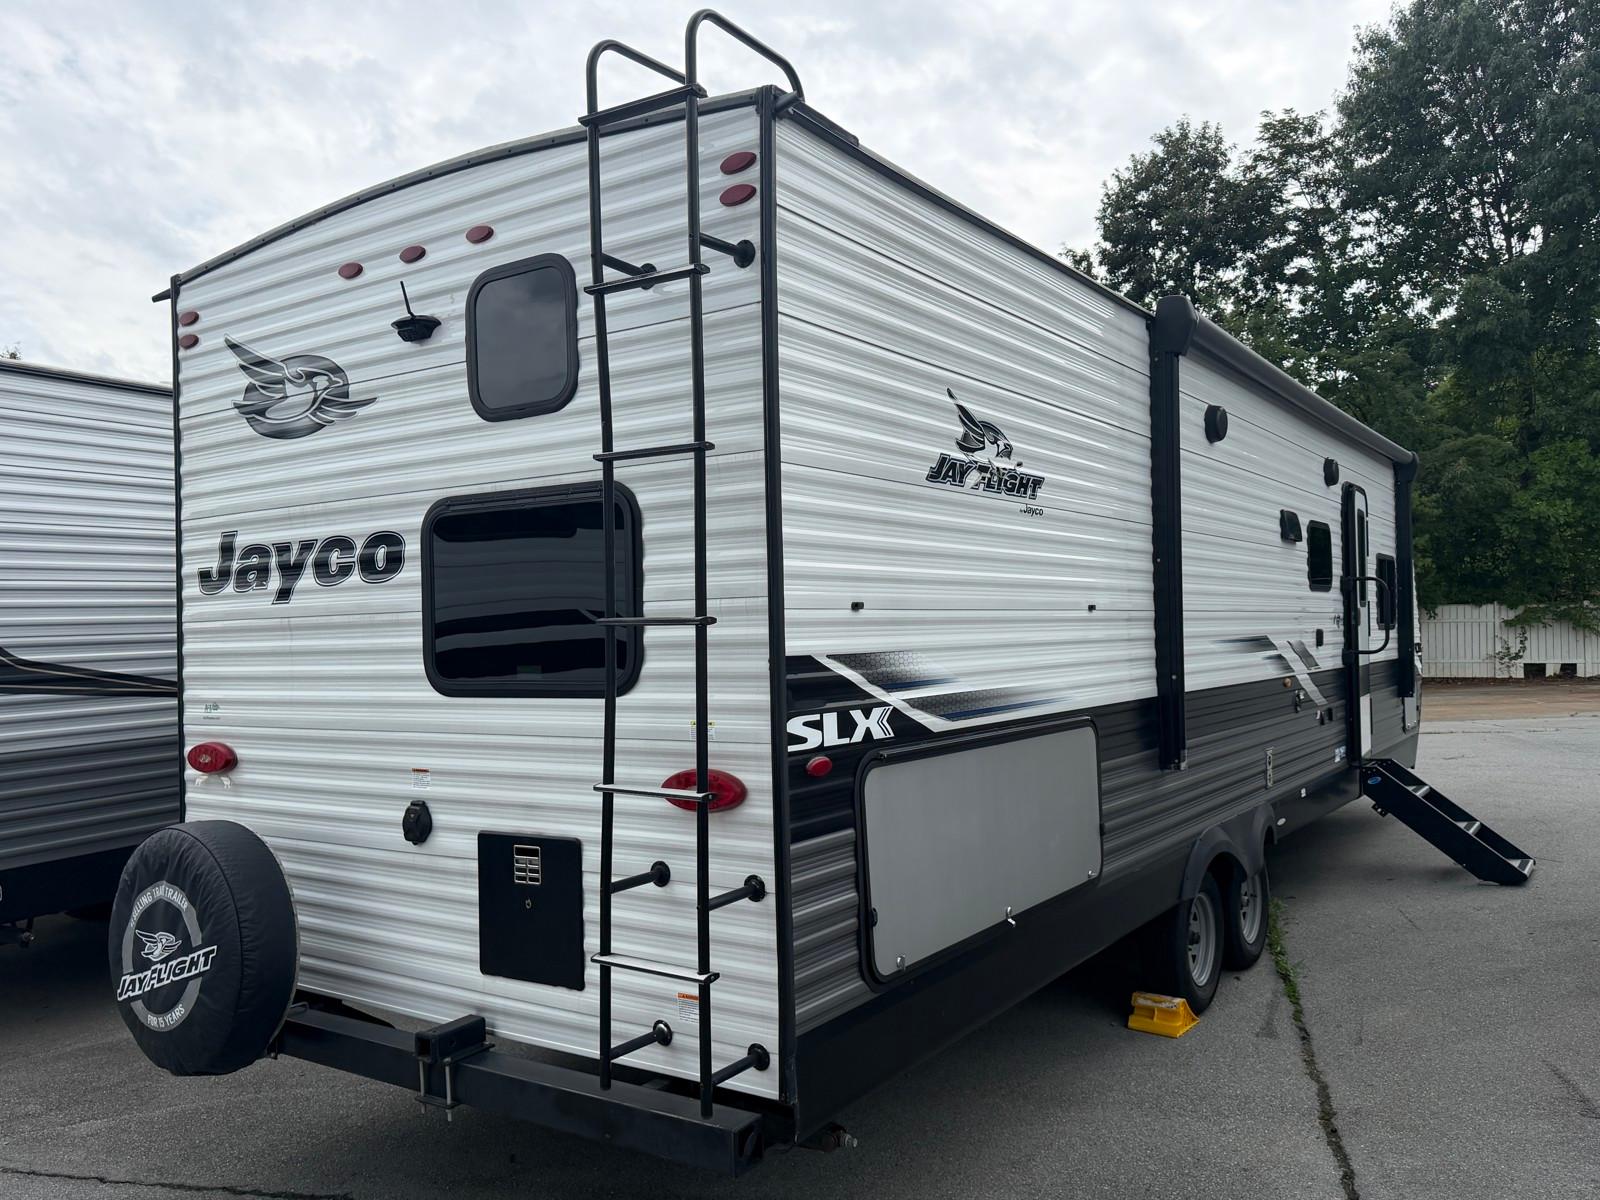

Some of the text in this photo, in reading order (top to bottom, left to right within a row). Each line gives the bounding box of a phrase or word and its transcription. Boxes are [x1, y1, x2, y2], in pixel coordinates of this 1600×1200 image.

[926, 453, 976, 487] JAY
[1023, 503, 1044, 517] Jayco
[198, 530, 406, 605] Jayco
[786, 706, 895, 752] SLX
[132, 891, 153, 921] SELLING
[165, 886, 188, 912] TRAILER
[147, 1014, 159, 1028] FOR
[164, 1003, 185, 1026] YEARS
